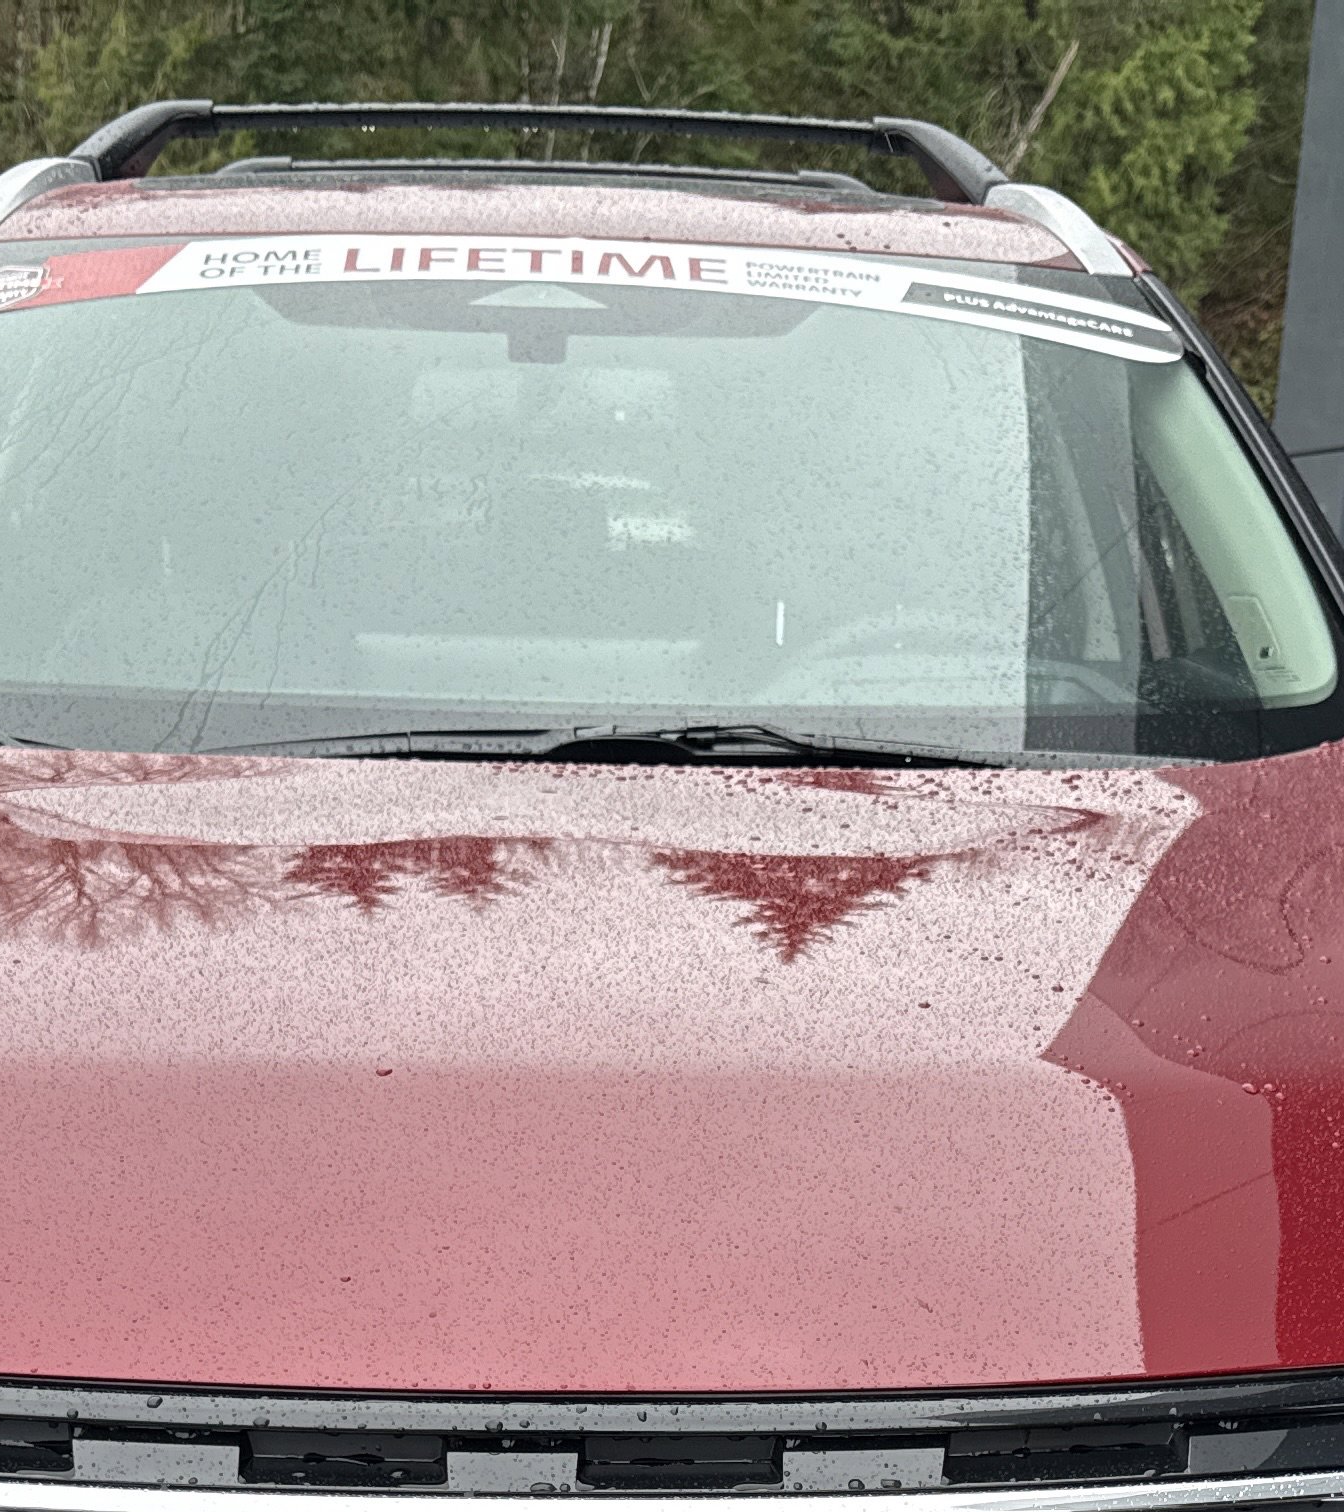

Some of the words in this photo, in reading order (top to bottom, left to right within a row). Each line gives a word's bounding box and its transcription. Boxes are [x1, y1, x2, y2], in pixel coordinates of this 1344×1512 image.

[203, 249, 322, 265] HOME
[344, 247, 728, 285] LIFETIME
[199, 266, 246, 280] OF
[257, 263, 322, 277] THE
[745, 261, 881, 283] POWERTRAIN
[746, 270, 830, 285] LIMITED
[746, 279, 862, 298] WARRANTY
[943, 291, 991, 308] PLUS
[992, 300, 1134, 338] AdvantageCARE
